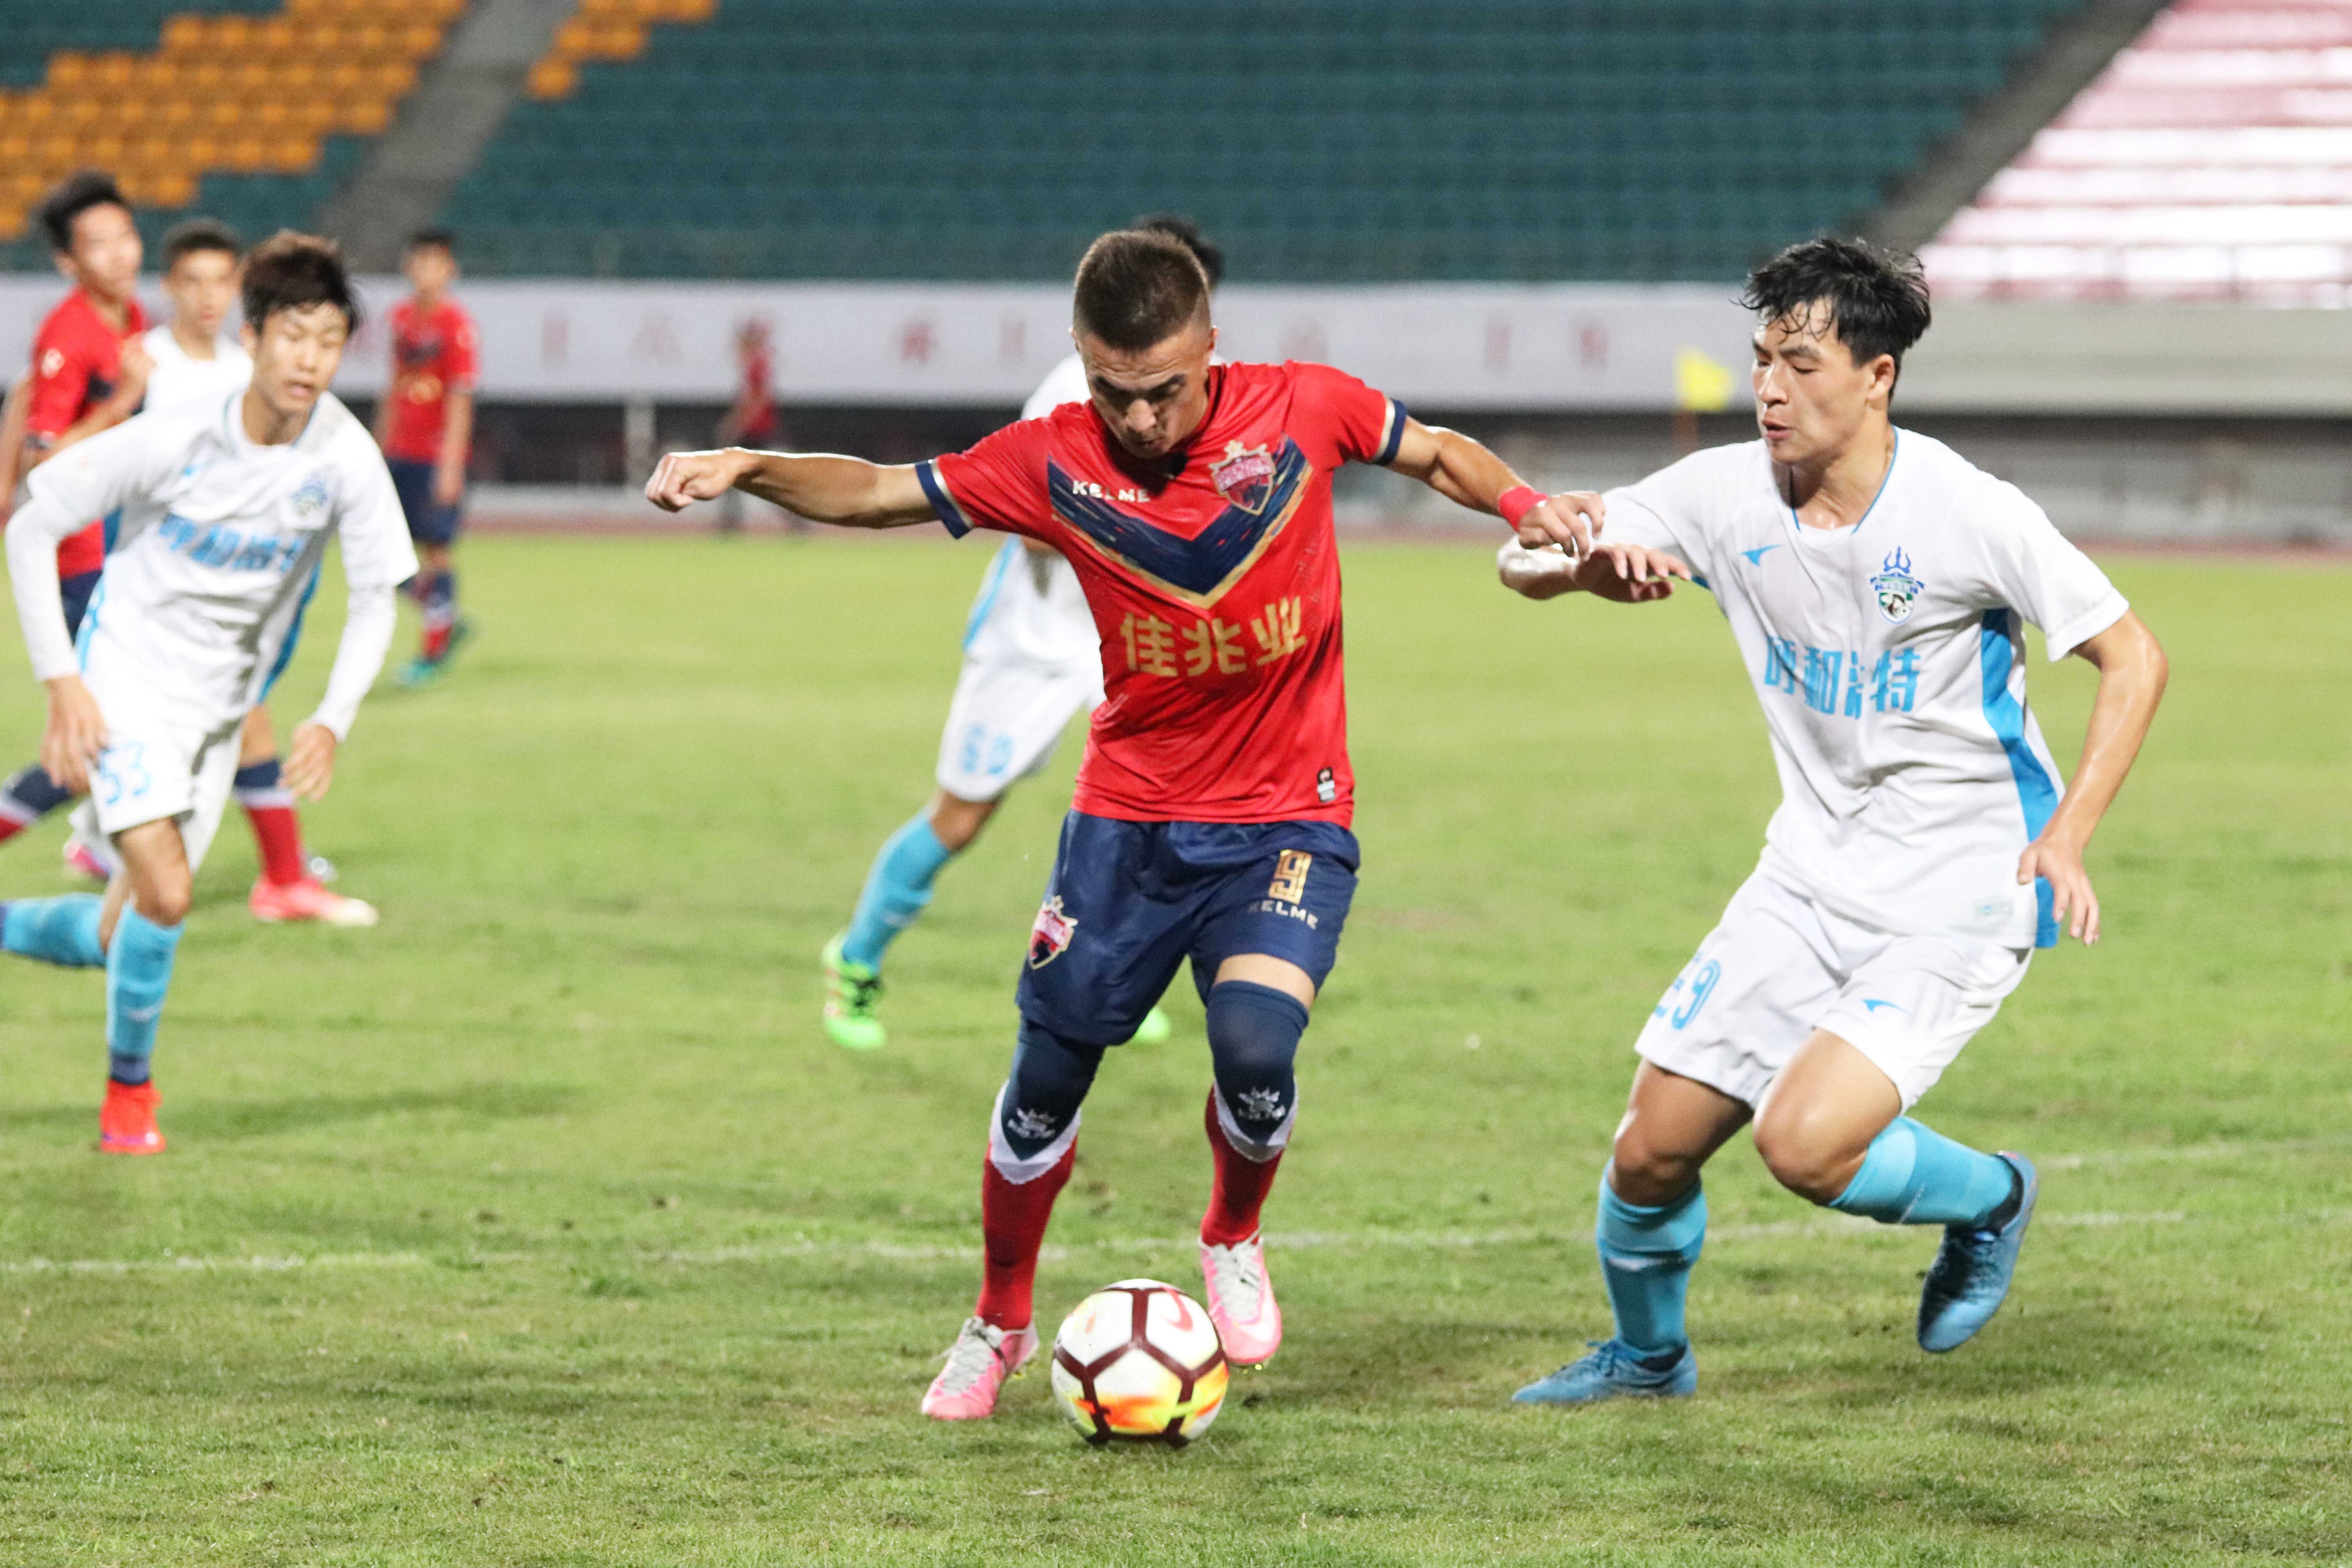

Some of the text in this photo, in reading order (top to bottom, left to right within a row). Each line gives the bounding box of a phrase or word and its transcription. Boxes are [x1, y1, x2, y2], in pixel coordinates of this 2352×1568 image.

[1072, 480, 1151, 503] KELME
[1120, 596, 1307, 677] 佳兆业
[1268, 849, 1312, 905] 9
[1655, 951, 1721, 1030] 9
